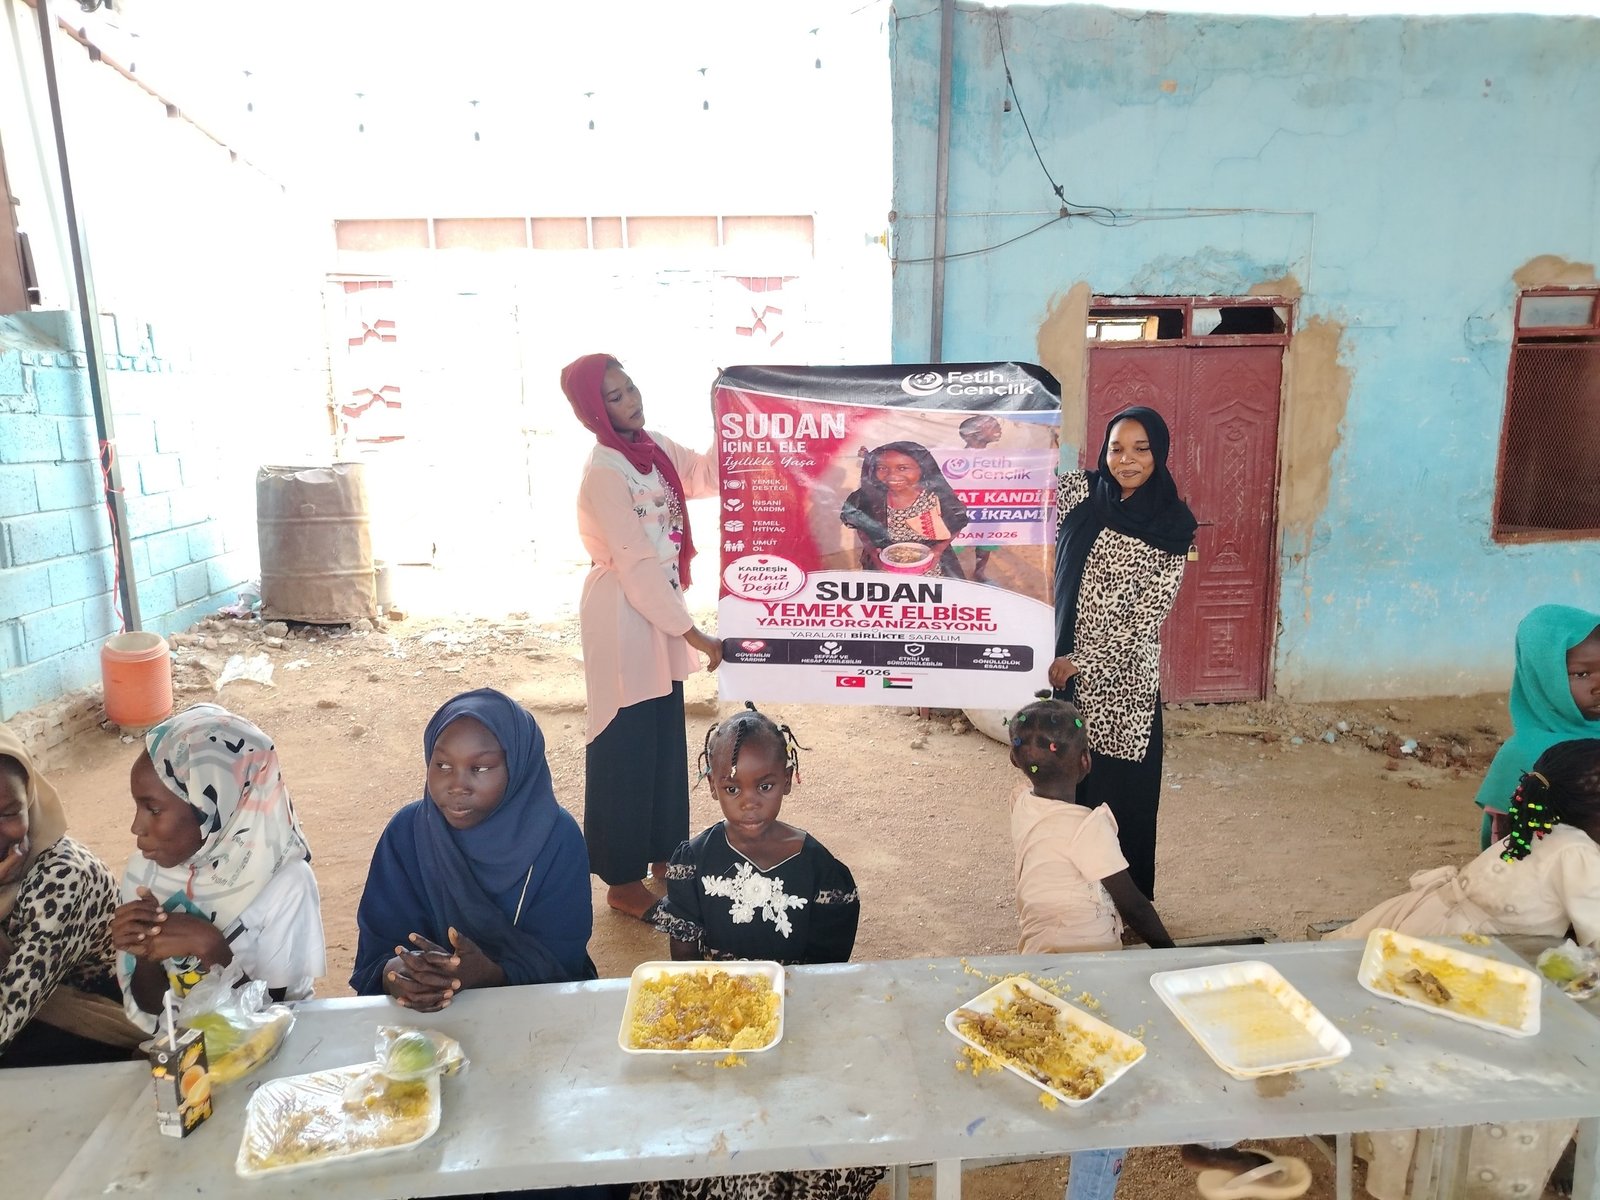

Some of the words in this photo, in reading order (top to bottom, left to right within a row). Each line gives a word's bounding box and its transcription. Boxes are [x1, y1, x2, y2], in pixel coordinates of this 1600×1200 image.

[948, 370, 1003, 384] Fetih
[946, 383, 1034, 396] Gençlik
[721, 413, 845, 439] SUDAN
[723, 440, 752, 454] İÇİN
[757, 442, 774, 453] EL
[780, 442, 806, 453] ELE
[722, 455, 775, 470] İyilikle
[780, 456, 816, 468] Yaşa
[973, 456, 1012, 468] Fetih
[972, 468, 1031, 480] Gençlik
[738, 565, 788, 573] KARDEŞİN
[737, 573, 788, 583] Yalnız
[741, 581, 789, 595] Değil!
[815, 581, 943, 604] SUDAN
[762, 603, 854, 618] YEMEK
[860, 604, 894, 619] VE
[901, 604, 992, 622] ELBİSE
[756, 618, 826, 628] YARDIM
[830, 618, 998, 632] ORGANİZASYONU
[790, 631, 847, 639] YARALARI
[851, 632, 905, 640] BİRLİKTE
[908, 634, 961, 642] SARALIM
[857, 668, 891, 676] 2026
